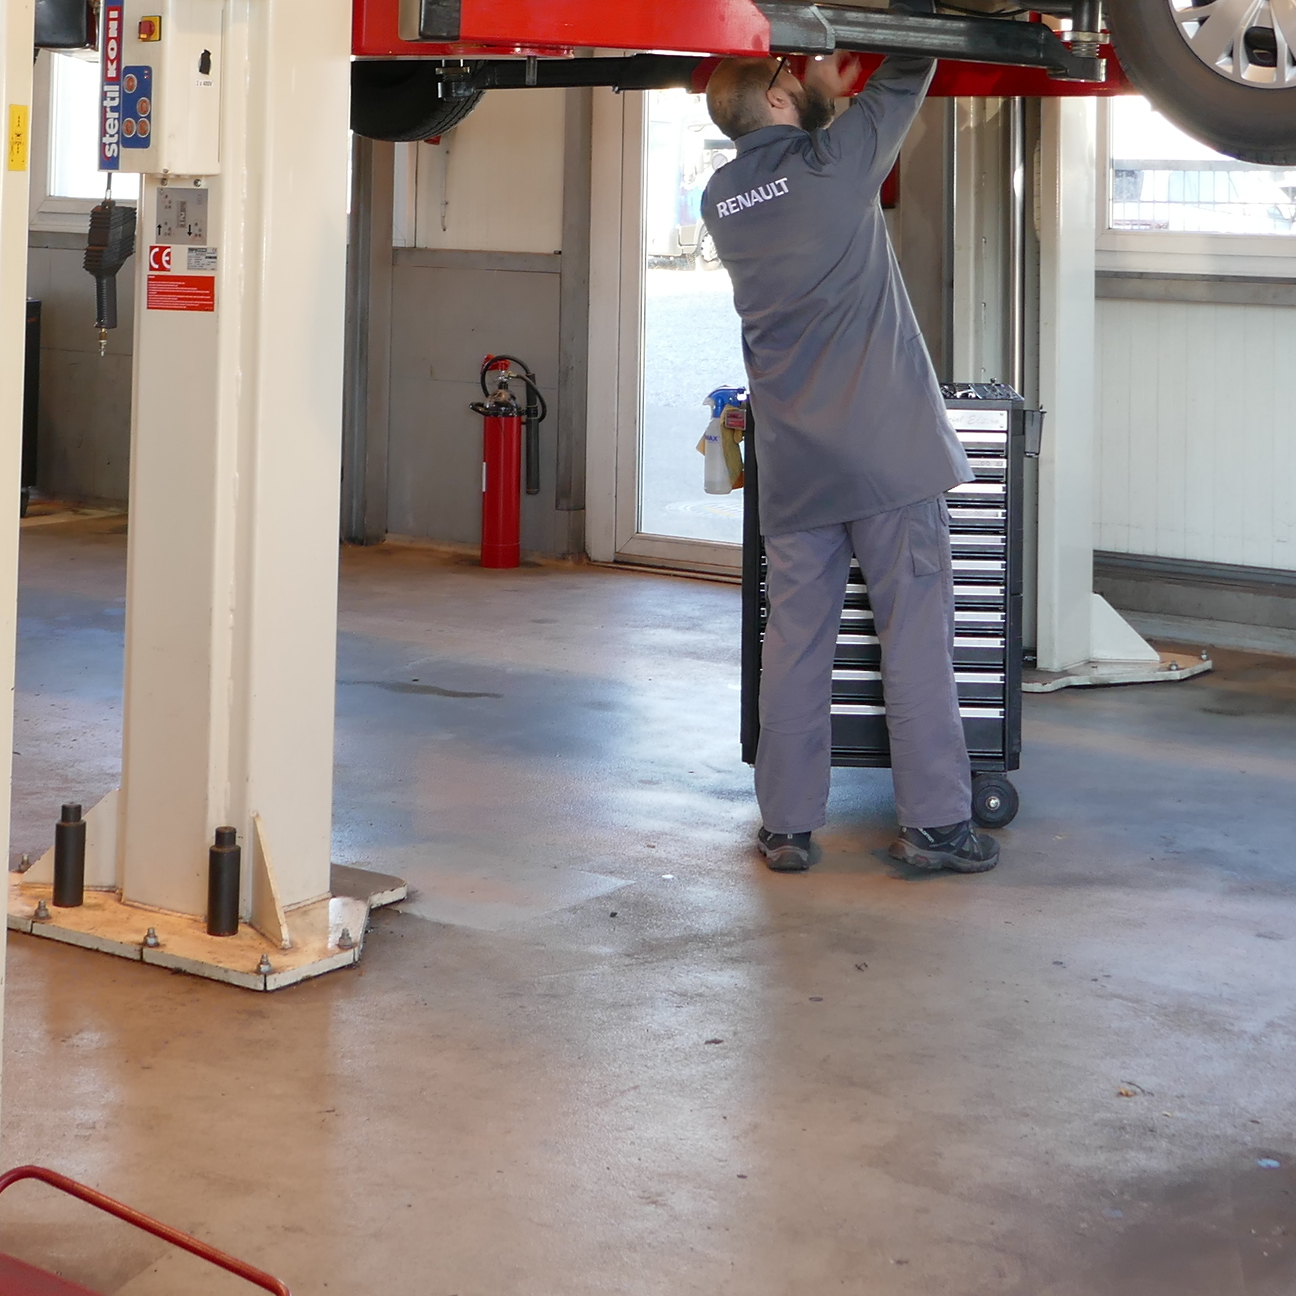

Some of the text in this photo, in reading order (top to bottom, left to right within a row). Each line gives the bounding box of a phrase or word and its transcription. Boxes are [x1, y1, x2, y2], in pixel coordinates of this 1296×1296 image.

[103, 10, 119, 157] stertil KONI
[716, 177, 789, 218] RENAULT
[150, 247, 171, 269] CE
